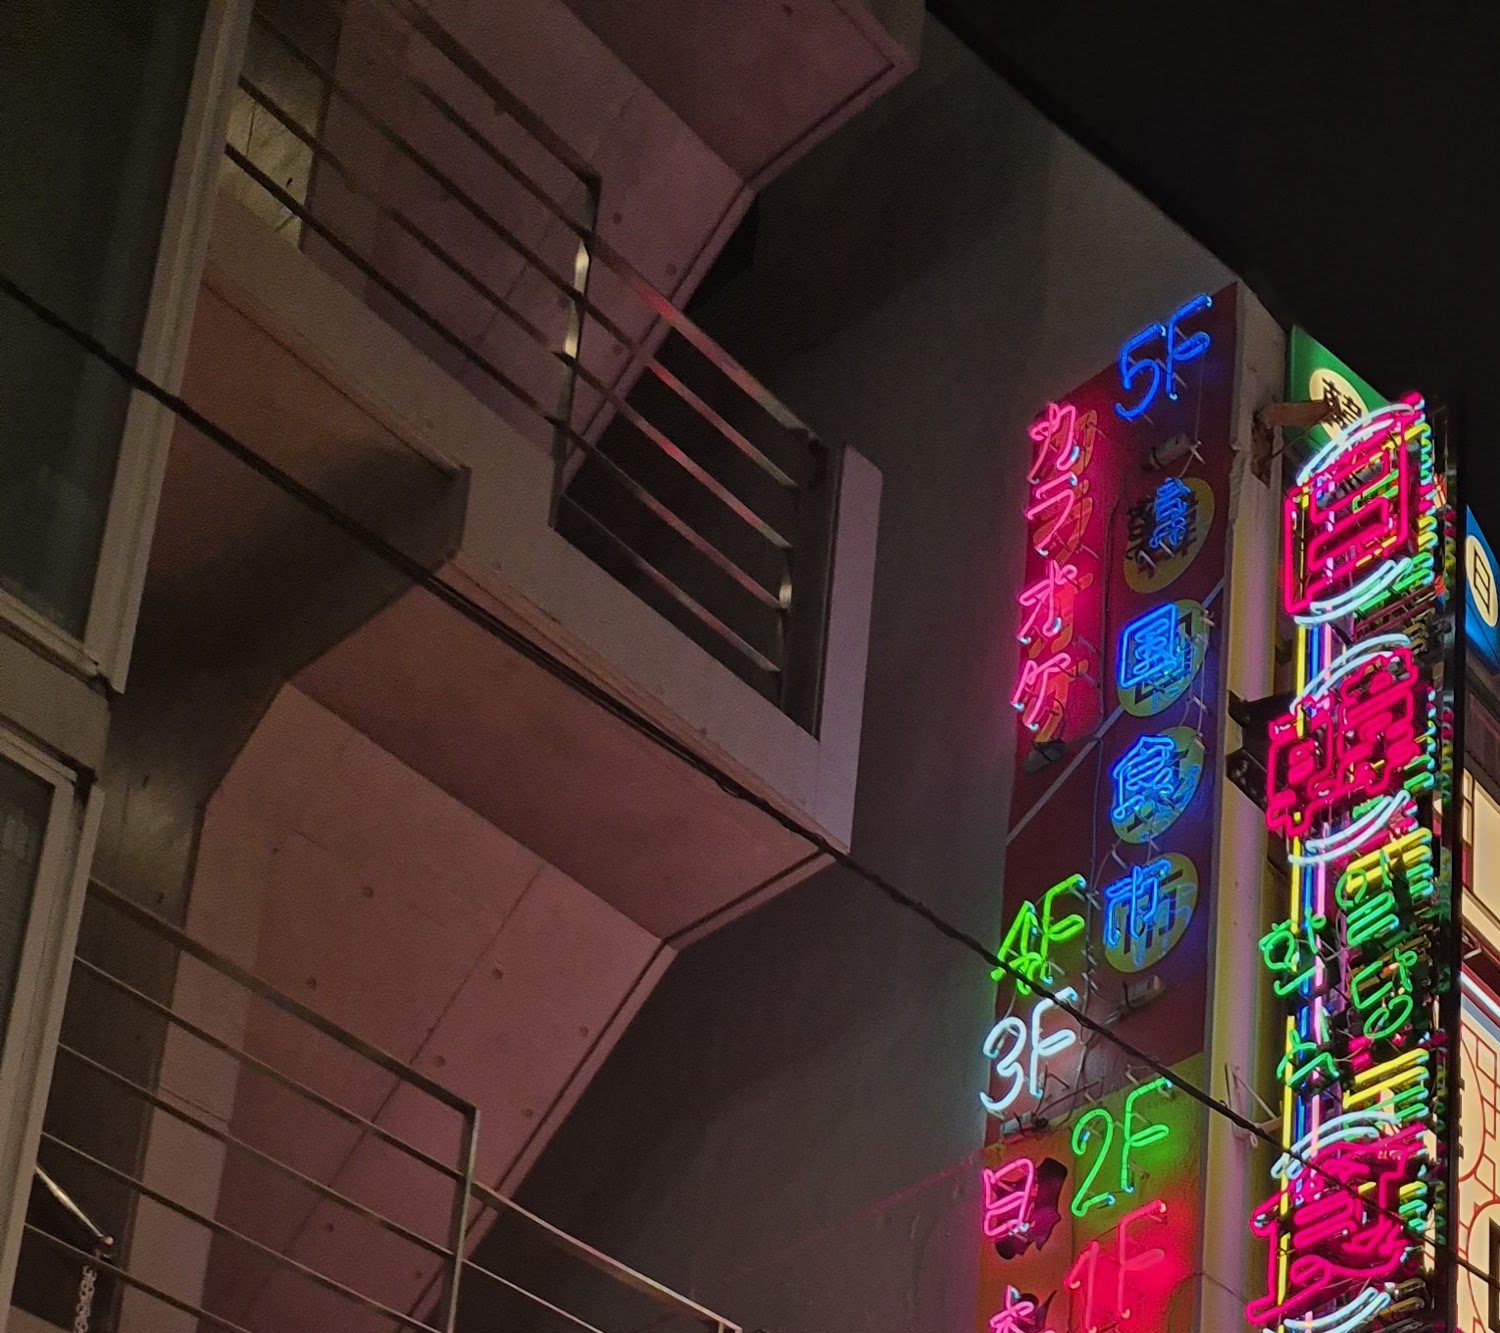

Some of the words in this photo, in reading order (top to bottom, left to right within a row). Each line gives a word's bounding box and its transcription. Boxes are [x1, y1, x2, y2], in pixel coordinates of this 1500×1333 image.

[1114, 292, 1213, 422] 5F
[1009, 400, 1098, 738] カラオケ
[1472, 548, 1494, 616] 日
[990, 873, 1088, 996] 4F
[980, 987, 1078, 1113] 3F
[1070, 1077, 1176, 1218] 2F
